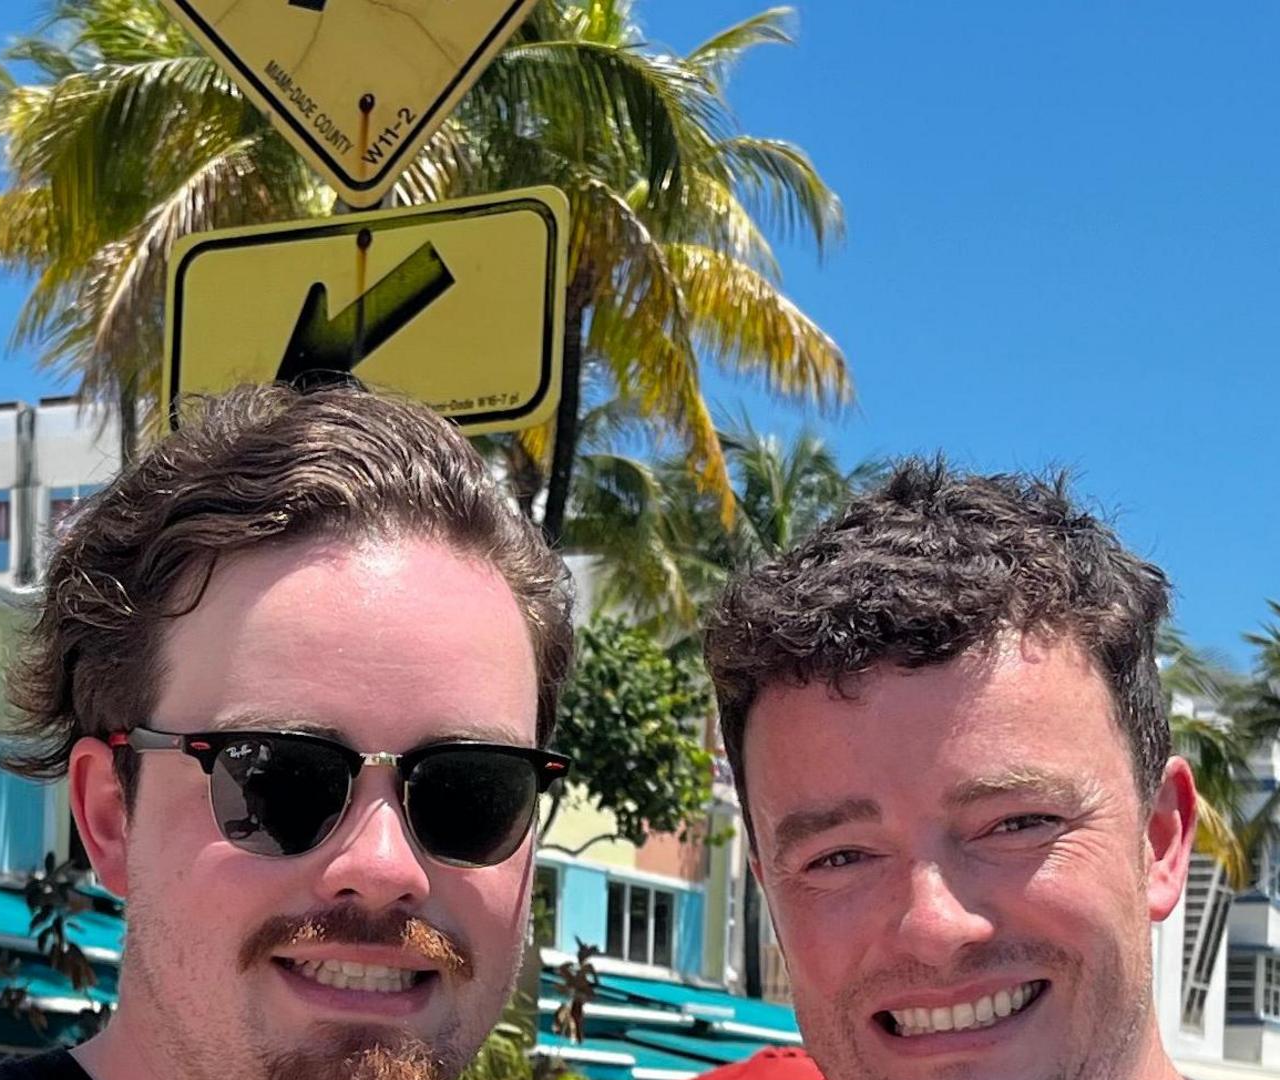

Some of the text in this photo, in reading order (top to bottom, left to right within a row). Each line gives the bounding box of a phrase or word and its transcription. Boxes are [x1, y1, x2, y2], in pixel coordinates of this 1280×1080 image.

[264, 60, 354, 156] MIAMI-DADE COUNTY
[361, 107, 417, 165] W11-2
